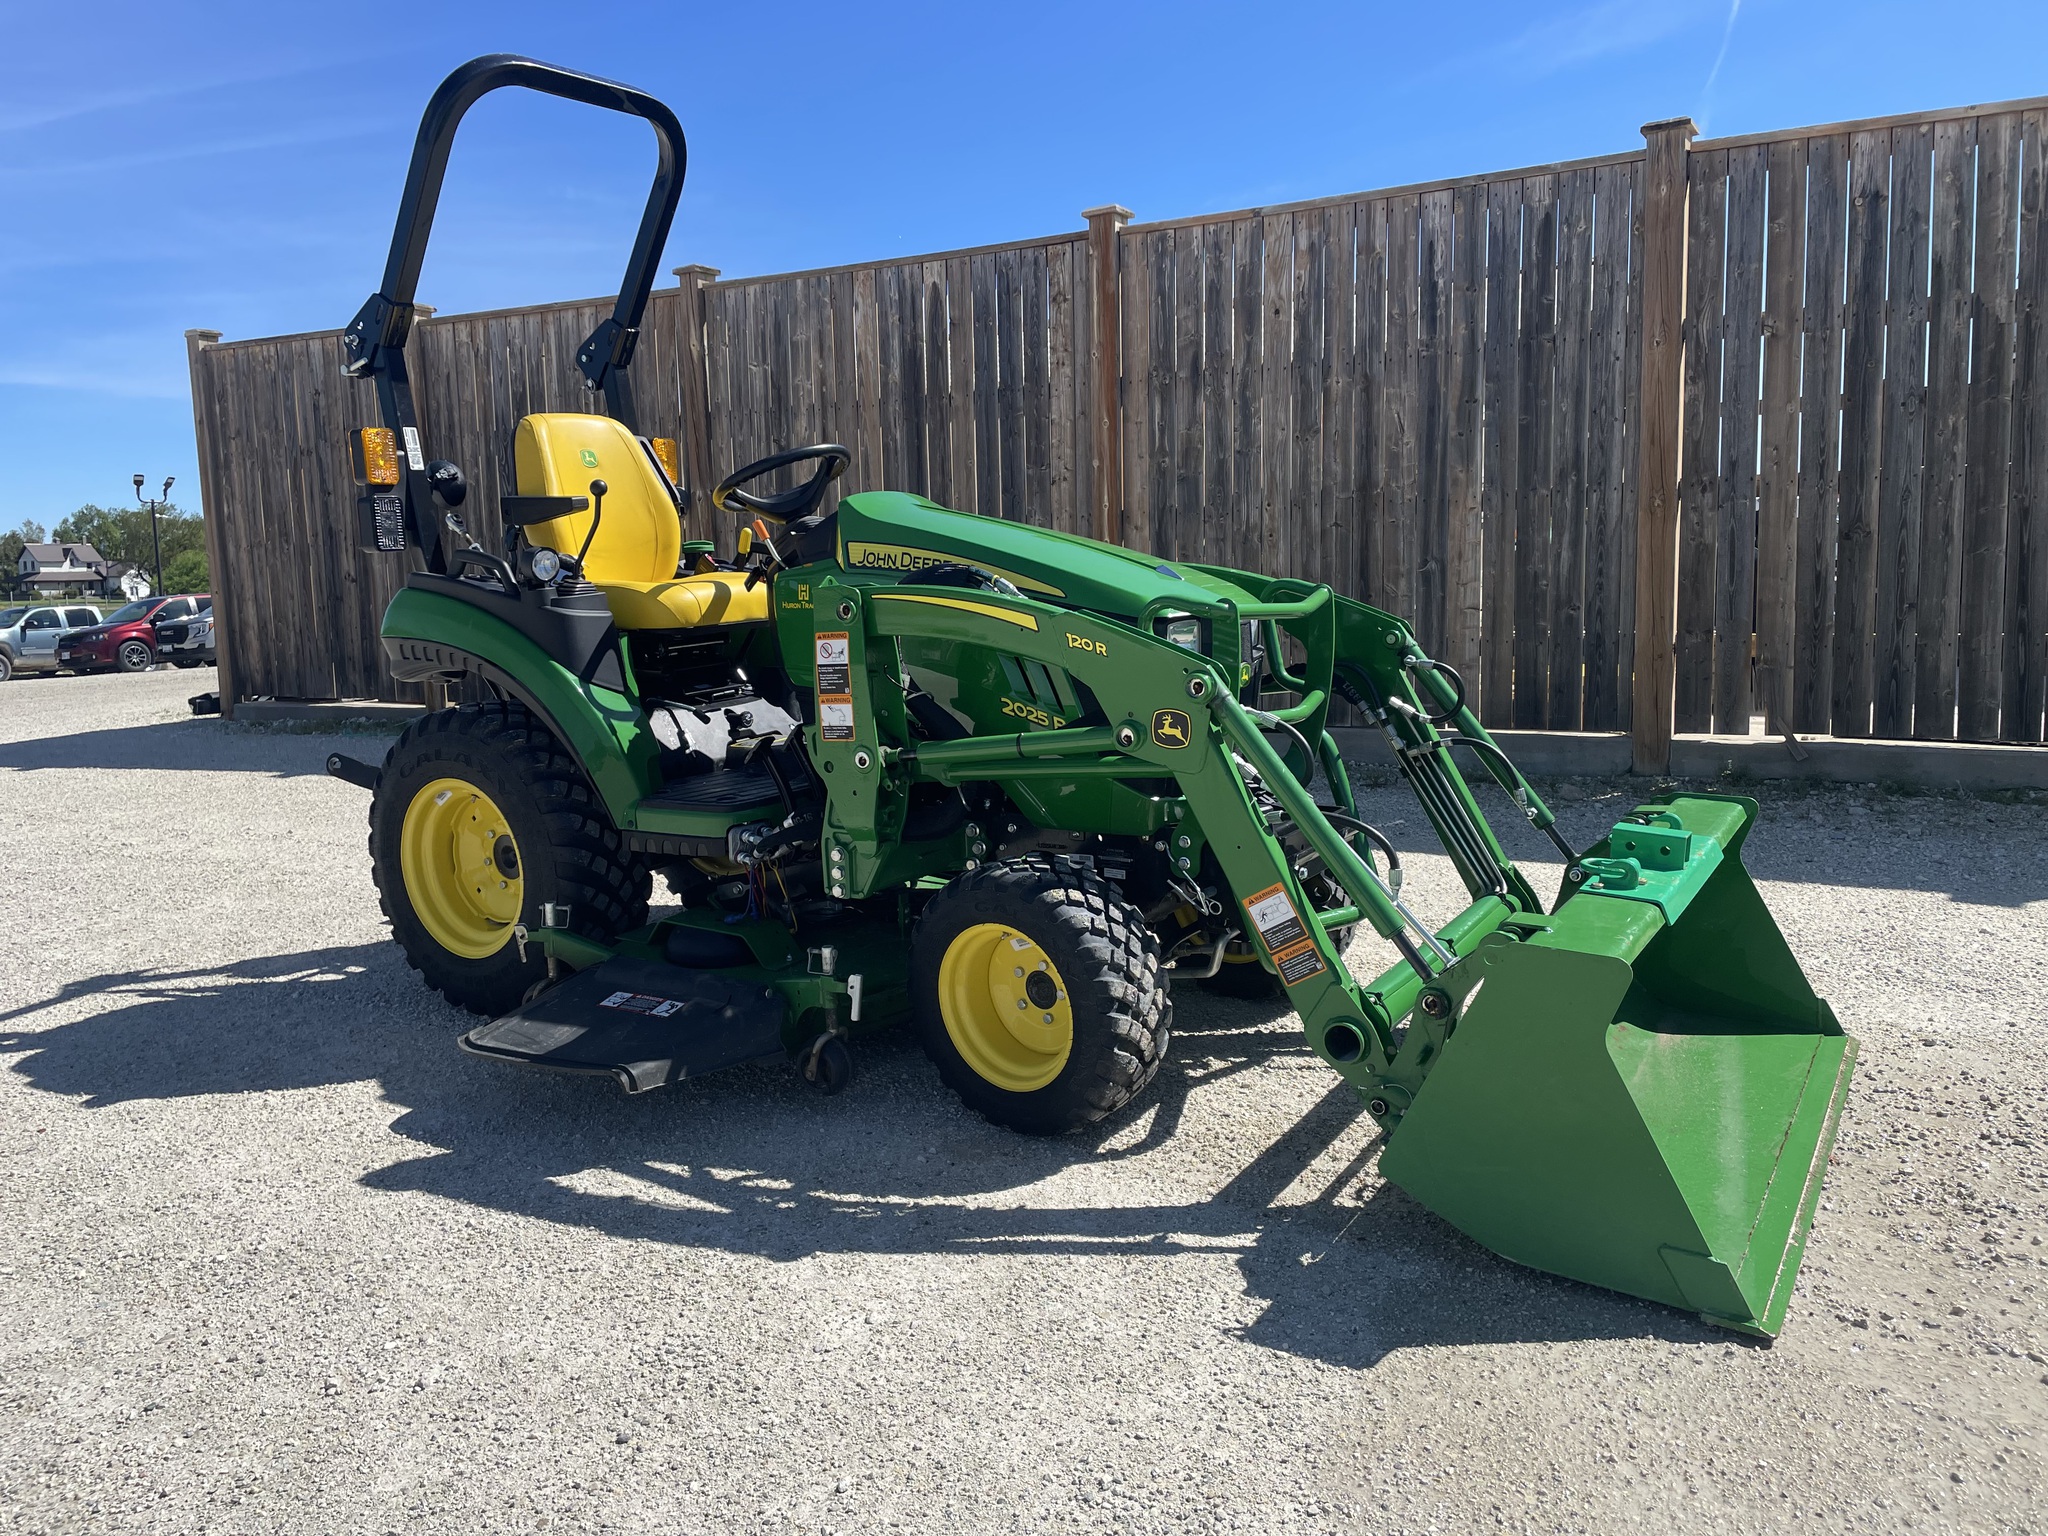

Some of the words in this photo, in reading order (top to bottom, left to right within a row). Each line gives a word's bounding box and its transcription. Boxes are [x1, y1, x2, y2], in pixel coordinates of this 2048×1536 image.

[858, 549, 897, 567] JOHN
[901, 552, 953, 569] DEE
[782, 601, 801, 609] HURON
[1065, 633, 1094, 652] 120
[1095, 641, 1108, 657] R
[1000, 698, 1049, 726] 2025
[1254, 886, 1279, 902] WARNING
[1284, 943, 1310, 959] WARNING
